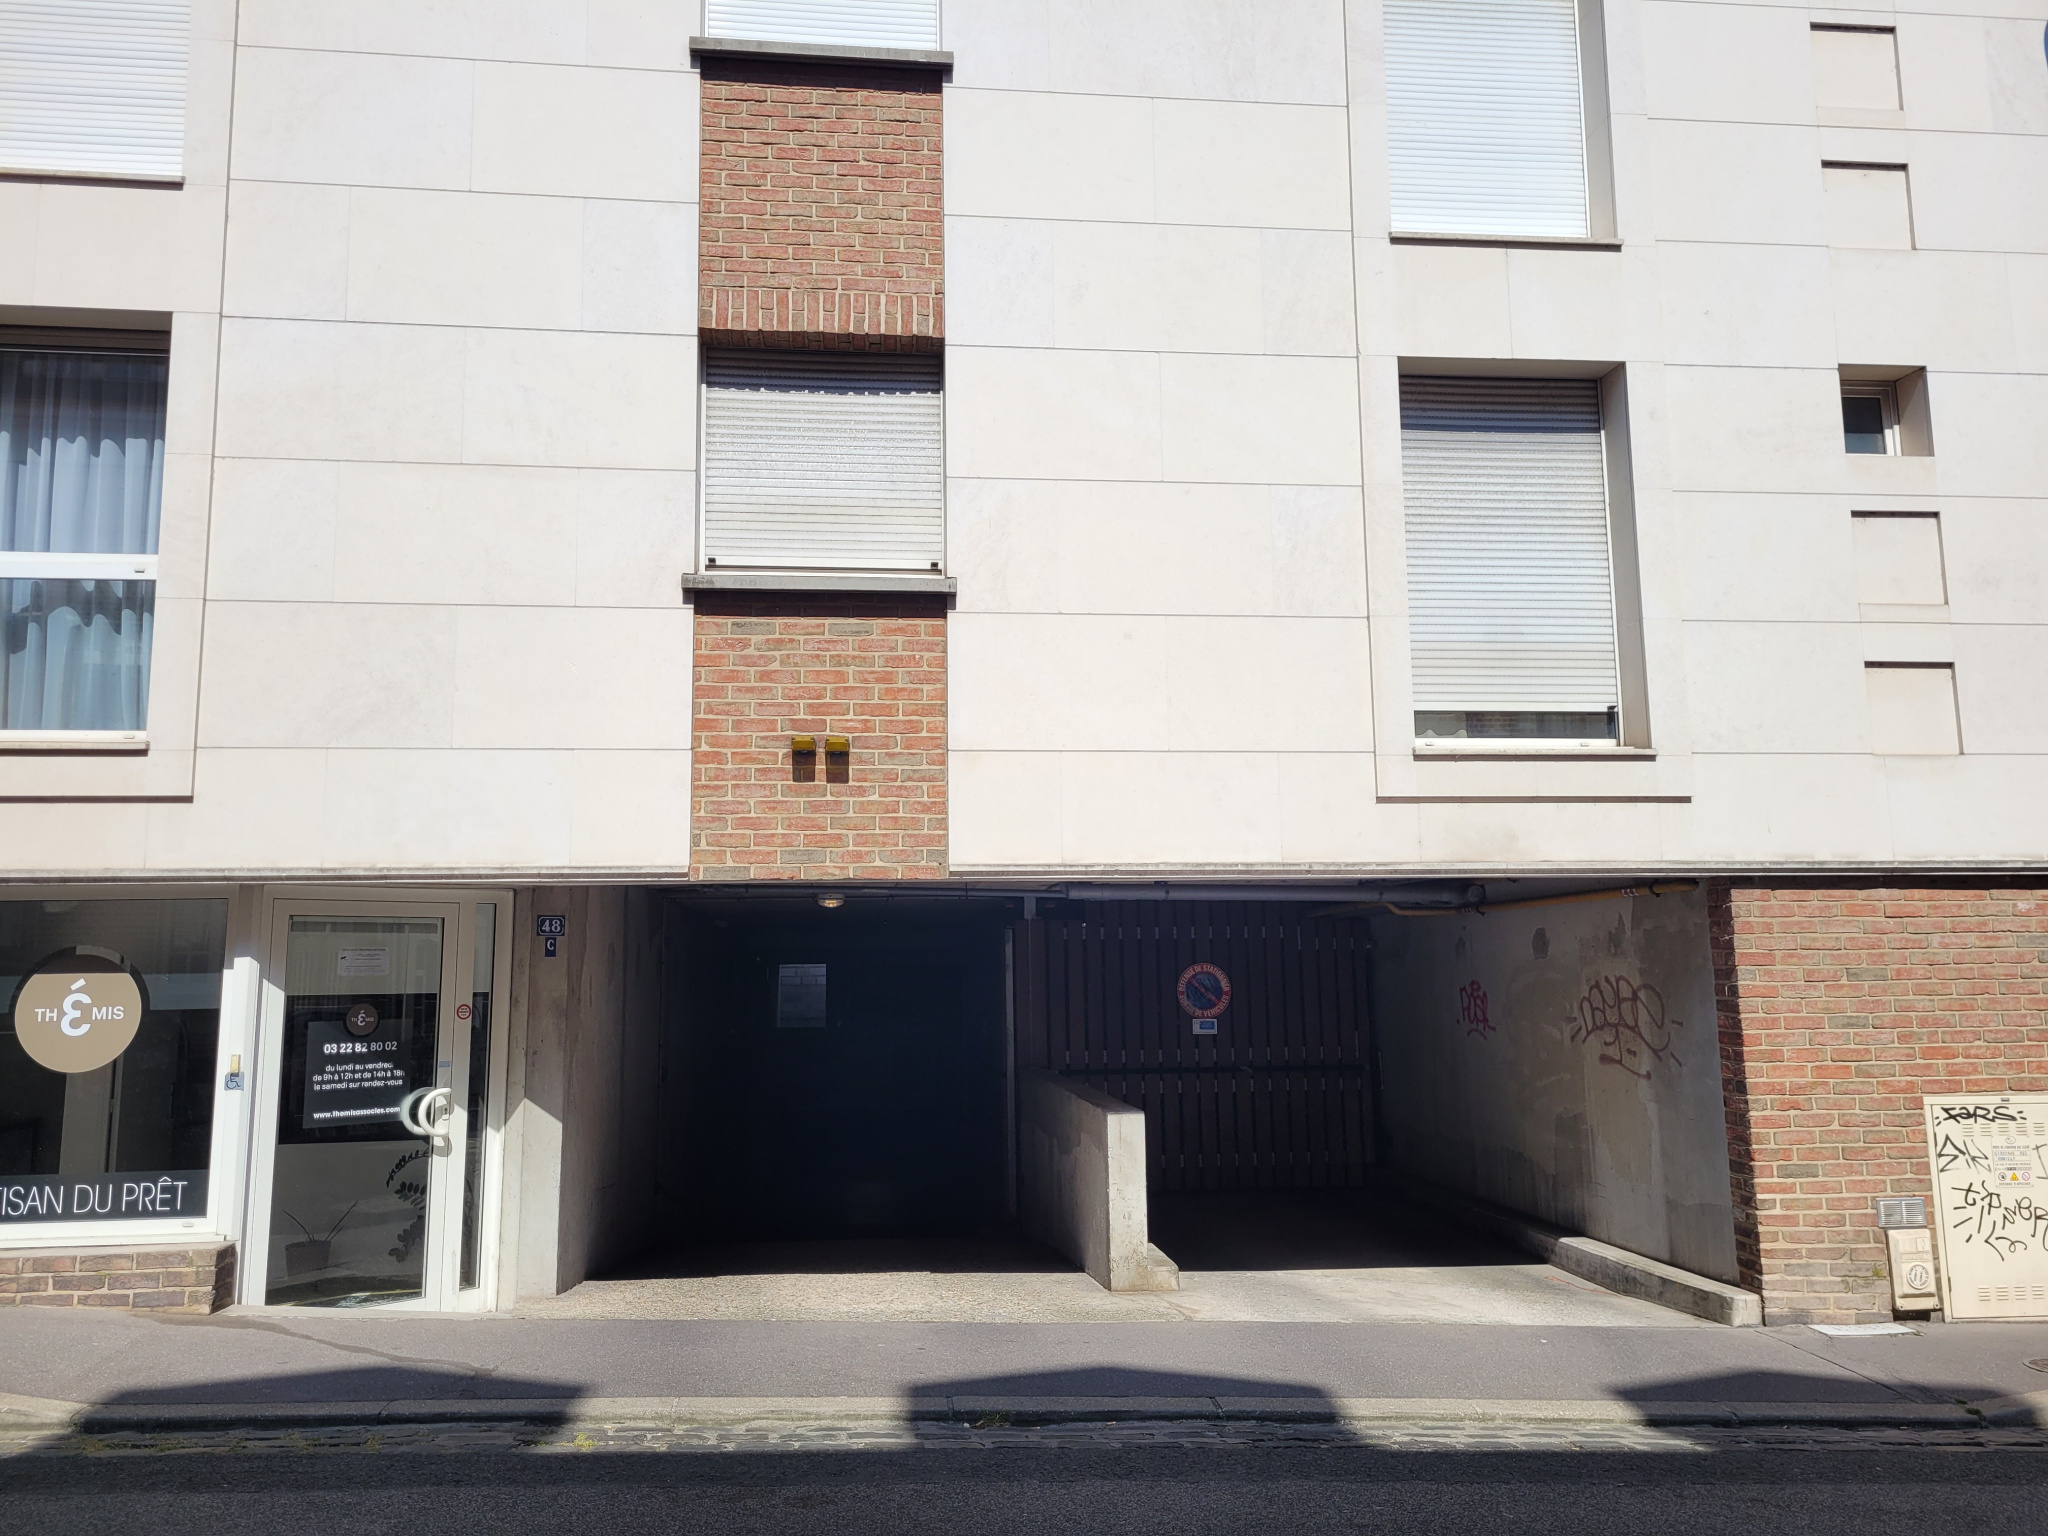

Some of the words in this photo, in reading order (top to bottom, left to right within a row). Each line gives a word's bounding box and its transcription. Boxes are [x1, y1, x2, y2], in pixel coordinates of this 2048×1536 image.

[541, 919, 562, 933] 48
[546, 939, 555, 951] C
[1203, 964, 1230, 991] STATIONNER
[1194, 1009, 1203, 1017] DE
[324, 1043, 337, 1054] 03
[339, 1043, 353, 1053] 22
[354, 1042, 368, 1052] 82
[370, 1042, 383, 1051] 80
[385, 1041, 398, 1050] 02
[325, 1064, 335, 1072] du
[336, 1063, 354, 1071] lundi
[334, 1072, 339, 1080] à
[393, 1069, 405, 1077] 18h
[313, 1083, 321, 1091] le
[322, 1081, 348, 1090] samedi
[361, 1079, 403, 1088] rendez-vous
[0, 1185, 63, 1216] ISAN
[74, 1183, 113, 1214] DU
[121, 1176, 187, 1213] PRÊT
